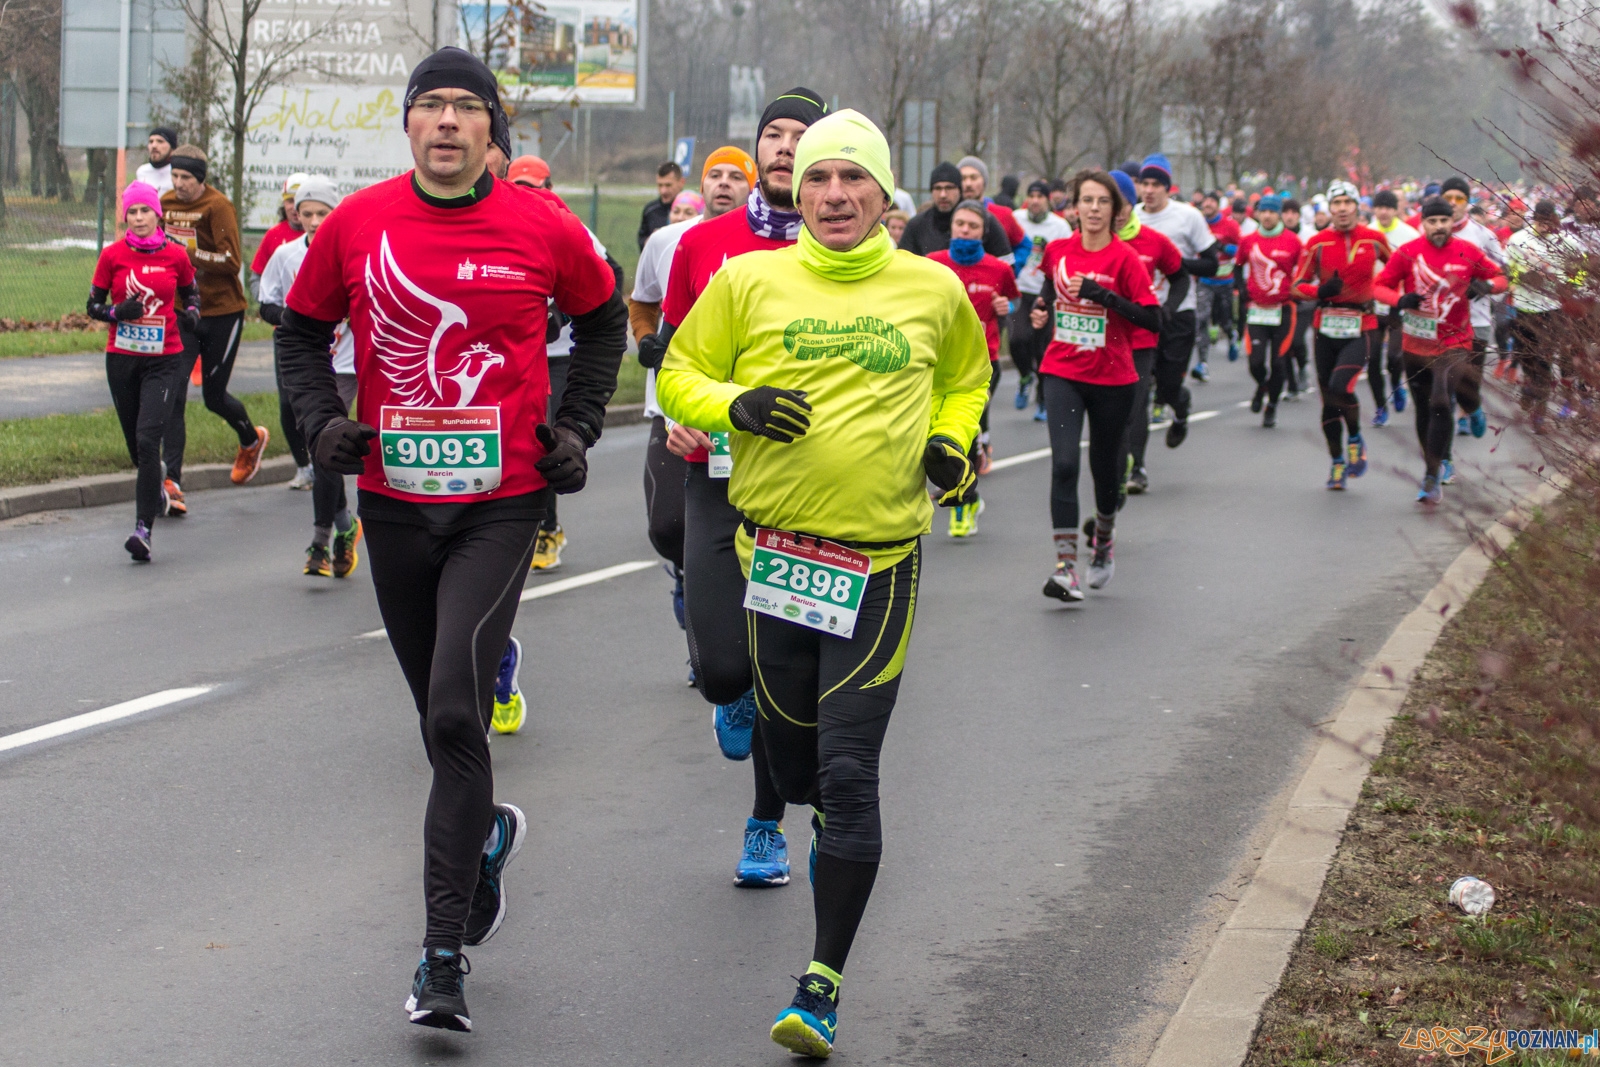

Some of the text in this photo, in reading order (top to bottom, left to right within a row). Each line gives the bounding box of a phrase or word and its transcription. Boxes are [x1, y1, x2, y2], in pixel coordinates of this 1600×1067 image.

[253, 19, 383, 46] REKLAMA
[226, 50, 409, 80] EWNĘTRZNA
[1061, 315, 1100, 333] 6830
[122, 325, 159, 341] 3333
[796, 336, 824, 346] ZIELONA
[826, 336, 845, 344] GÓRO
[846, 334, 875, 342] ZACZNIJ
[442, 417, 491, 426] RunPoland.org
[712, 437, 719, 445] C
[396, 437, 488, 465] 9093
[818, 549, 864, 568] RunPoland.org
[766, 557, 853, 604] 2898
[751, 595, 769, 604] GRUPA
[790, 595, 817, 608] Mariusz
